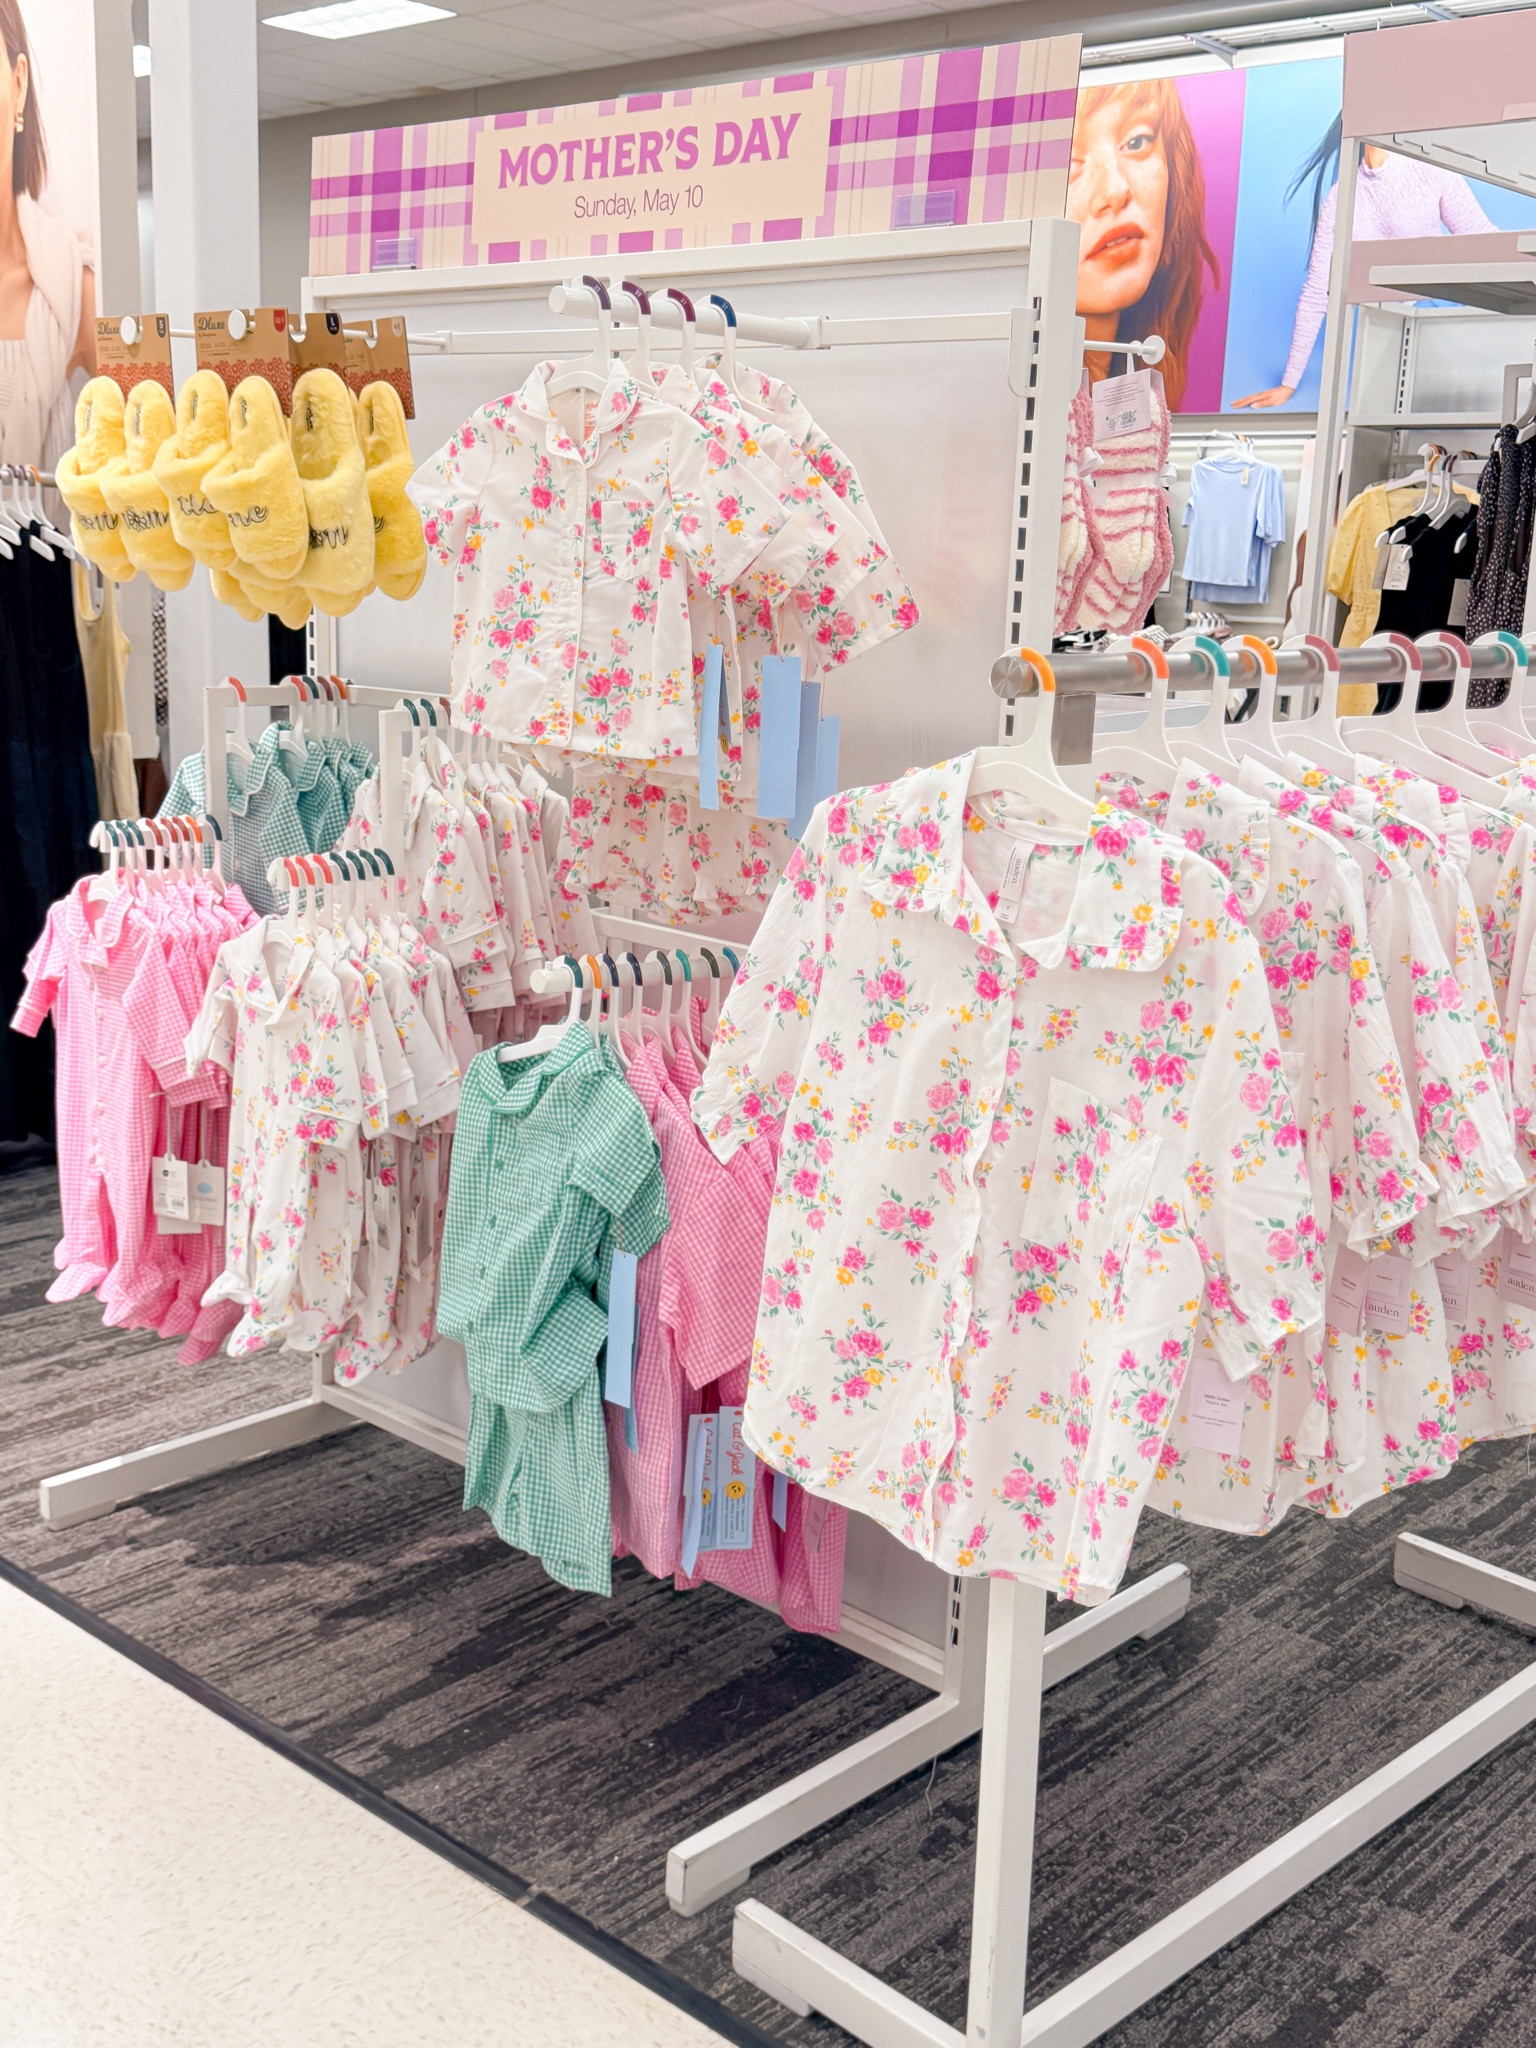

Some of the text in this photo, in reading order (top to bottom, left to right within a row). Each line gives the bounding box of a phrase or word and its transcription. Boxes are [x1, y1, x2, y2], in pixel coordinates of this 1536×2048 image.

[498, 113, 802, 189] MOTHER'S DAY
[574, 184, 704, 219] Sunday, May 10
[198, 316, 225, 331] Dluxe
[330, 316, 335, 326] L
